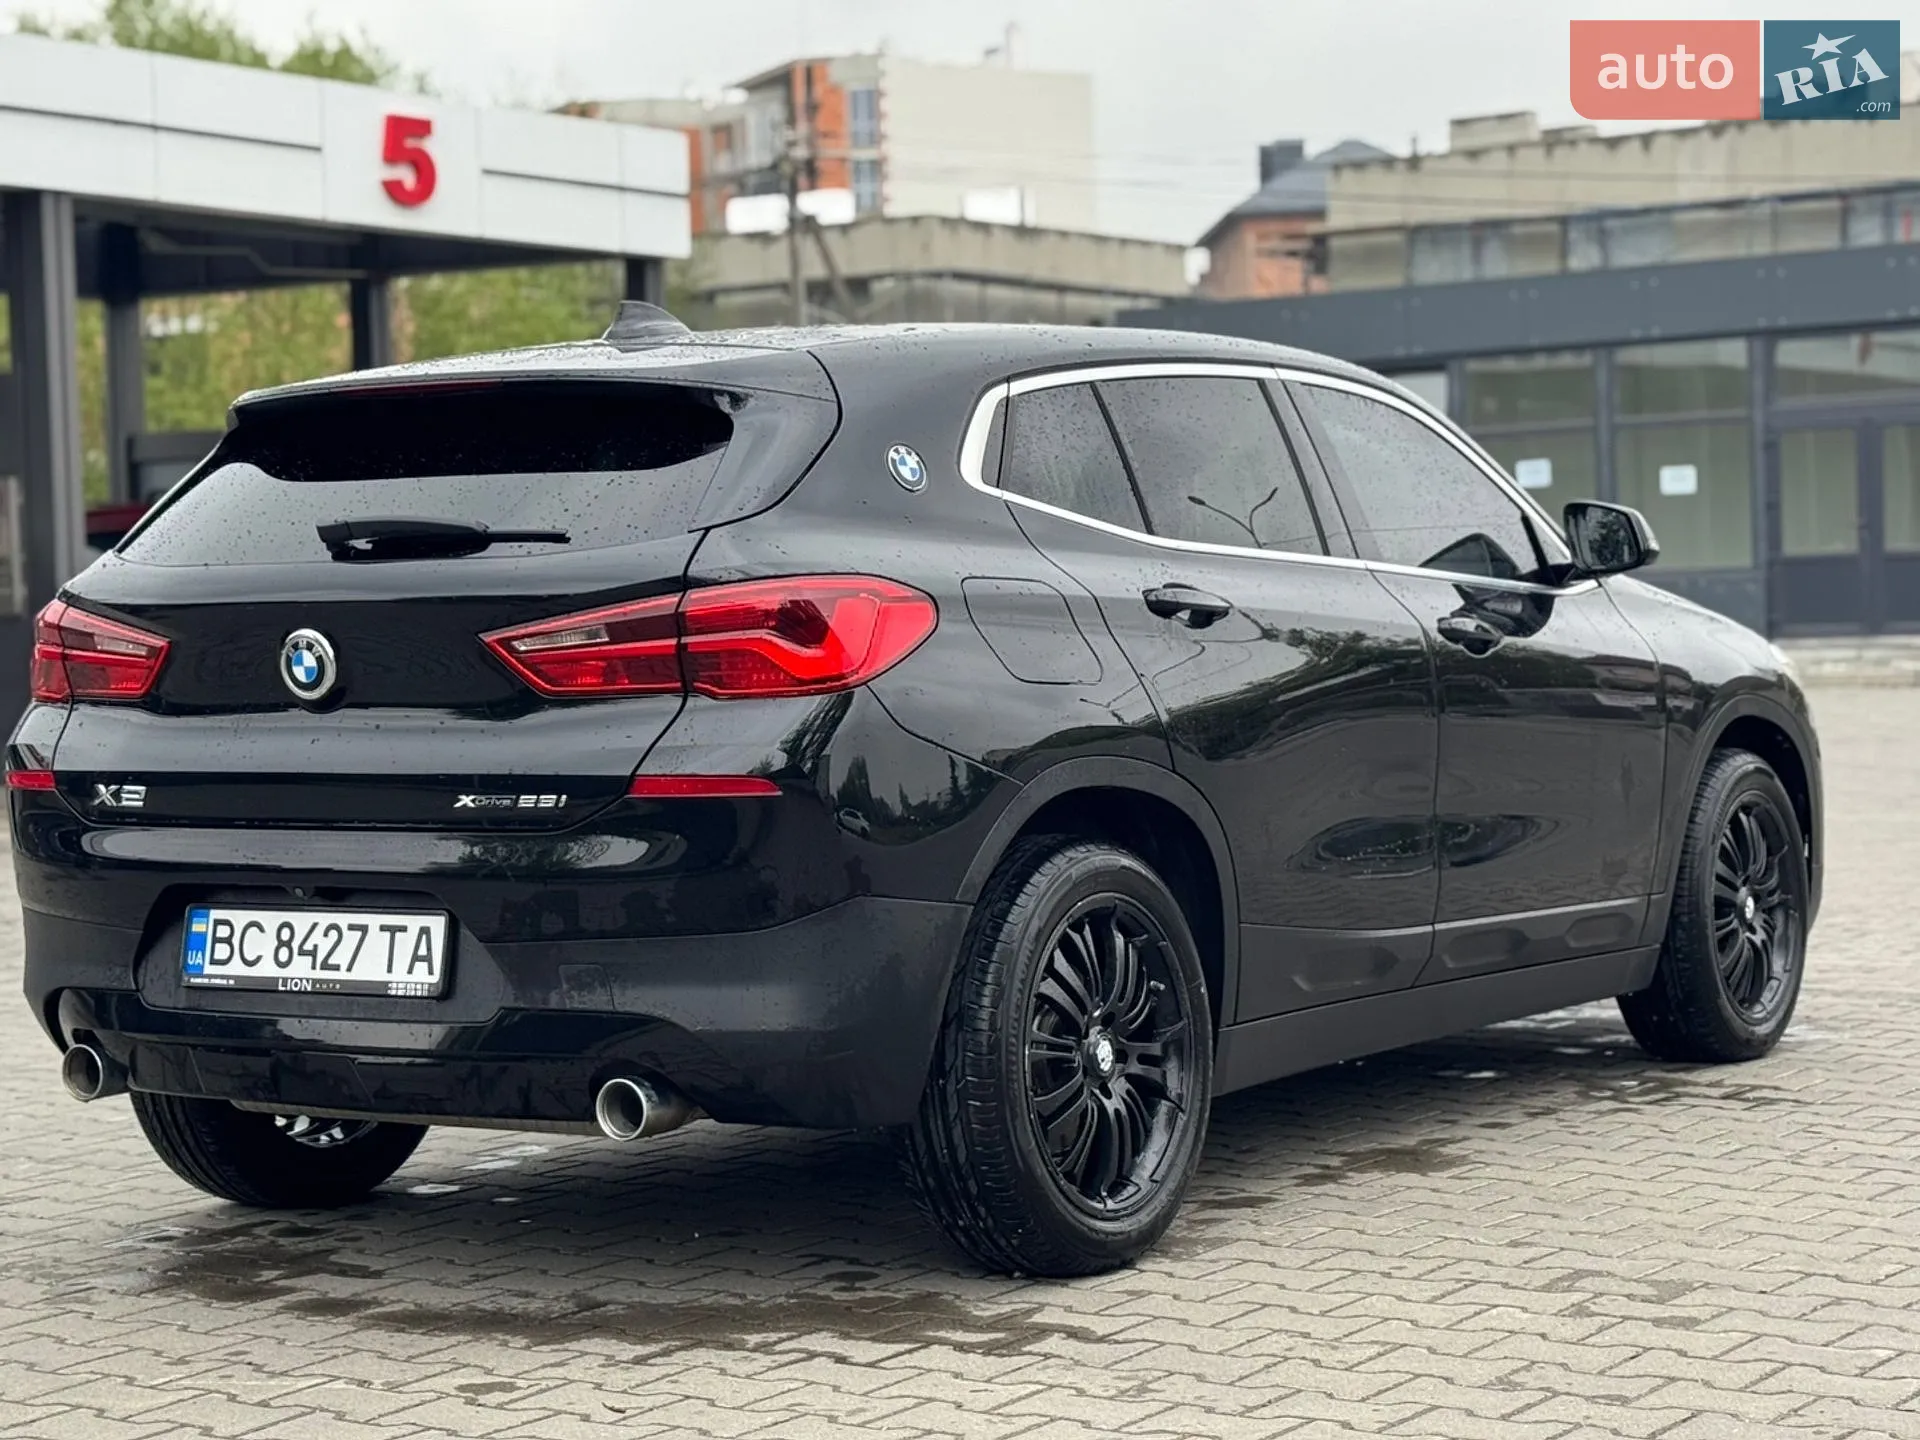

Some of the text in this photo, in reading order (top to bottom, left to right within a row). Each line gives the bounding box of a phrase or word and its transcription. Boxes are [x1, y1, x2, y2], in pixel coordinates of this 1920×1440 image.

[381, 114, 436, 209] 5
[92, 783, 147, 807] X2
[187, 949, 204, 966] UA
[209, 918, 434, 976] BC 8427 TA
[278, 978, 312, 991] LION
